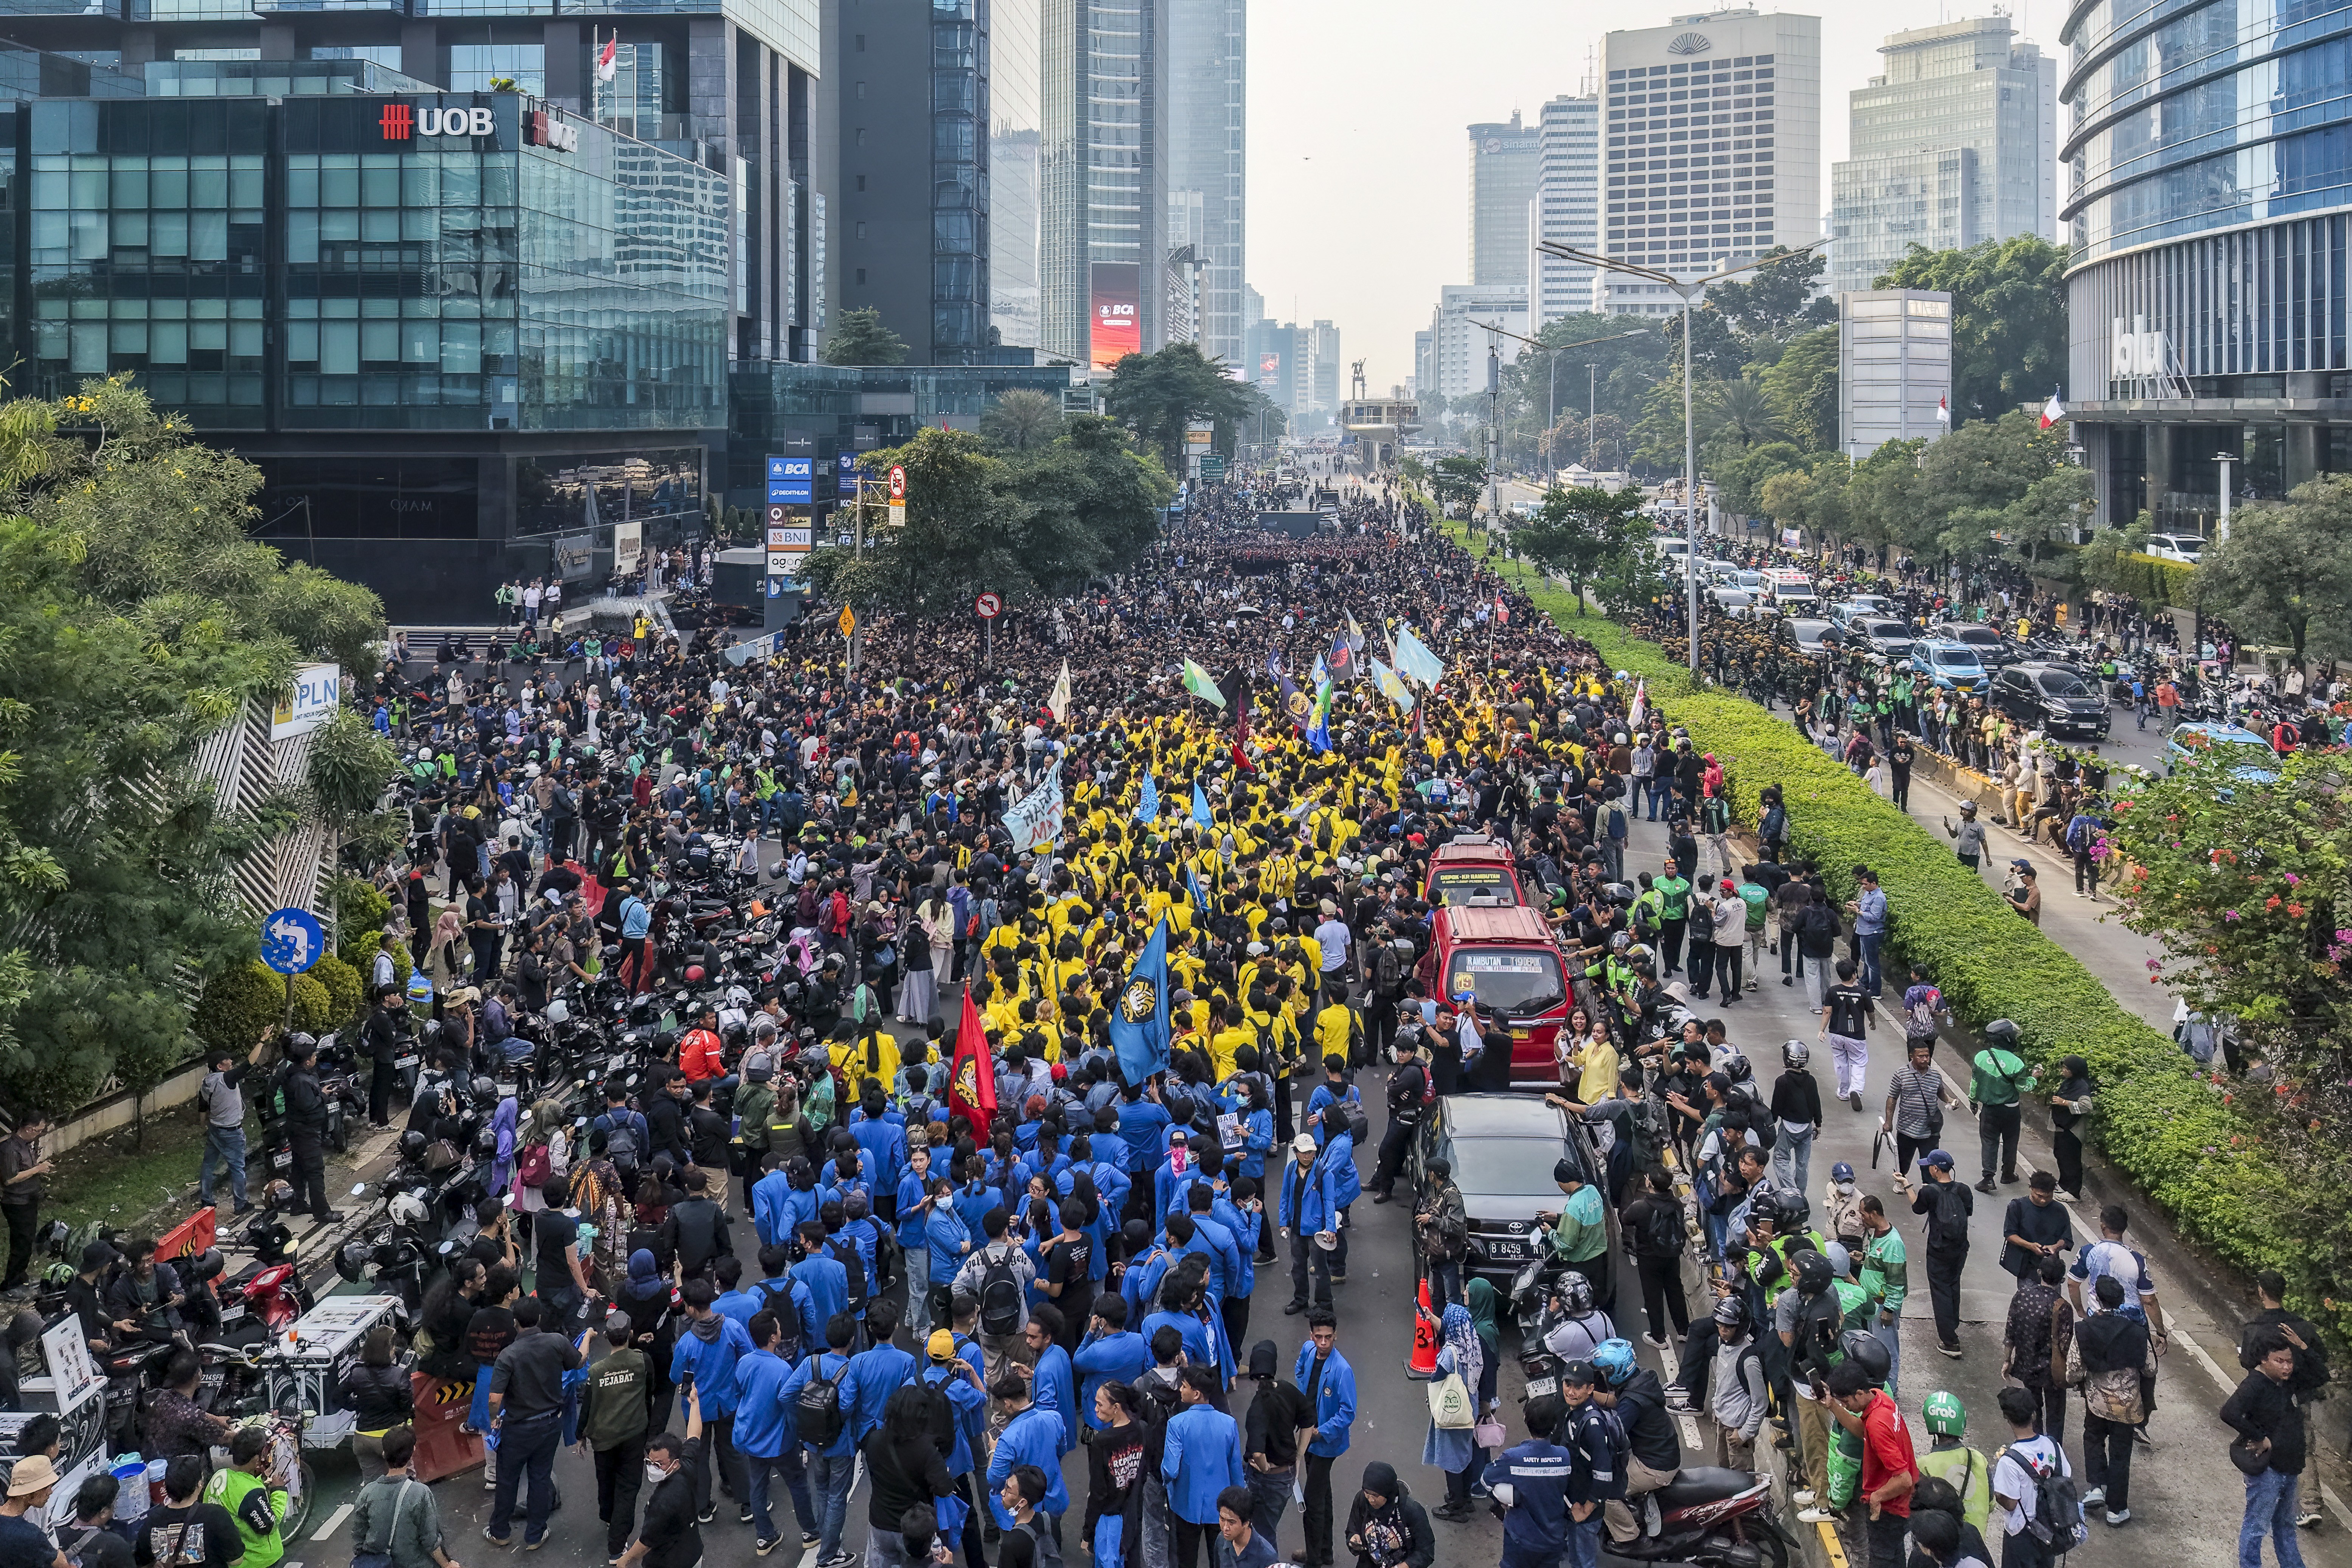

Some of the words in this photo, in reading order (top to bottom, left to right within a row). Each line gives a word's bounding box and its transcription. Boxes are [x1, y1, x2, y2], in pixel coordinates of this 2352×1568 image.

[418, 108, 494, 136] UOB
[547, 118, 578, 153] UOB
[1112, 304, 1134, 315] BCA
[2113, 314, 2163, 375] blu
[785, 464, 809, 475] BCA
[785, 533, 806, 542] BNI
[299, 678, 337, 708] PLN
[1468, 957, 1501, 966] RAMBUTAN
[1457, 974, 1473, 988] 19
[1986, 1056, 2006, 1068] Gb
[1491, 1243, 1497, 1254] B
[1501, 1243, 1521, 1254] 8459
[1839, 1288, 1854, 1300] ab
[599, 1373, 634, 1387] PEJABAT
[1532, 1380, 1546, 1389] 6555
[1928, 1405, 1956, 1419] Grab
[250, 1510, 266, 1528] gopay
